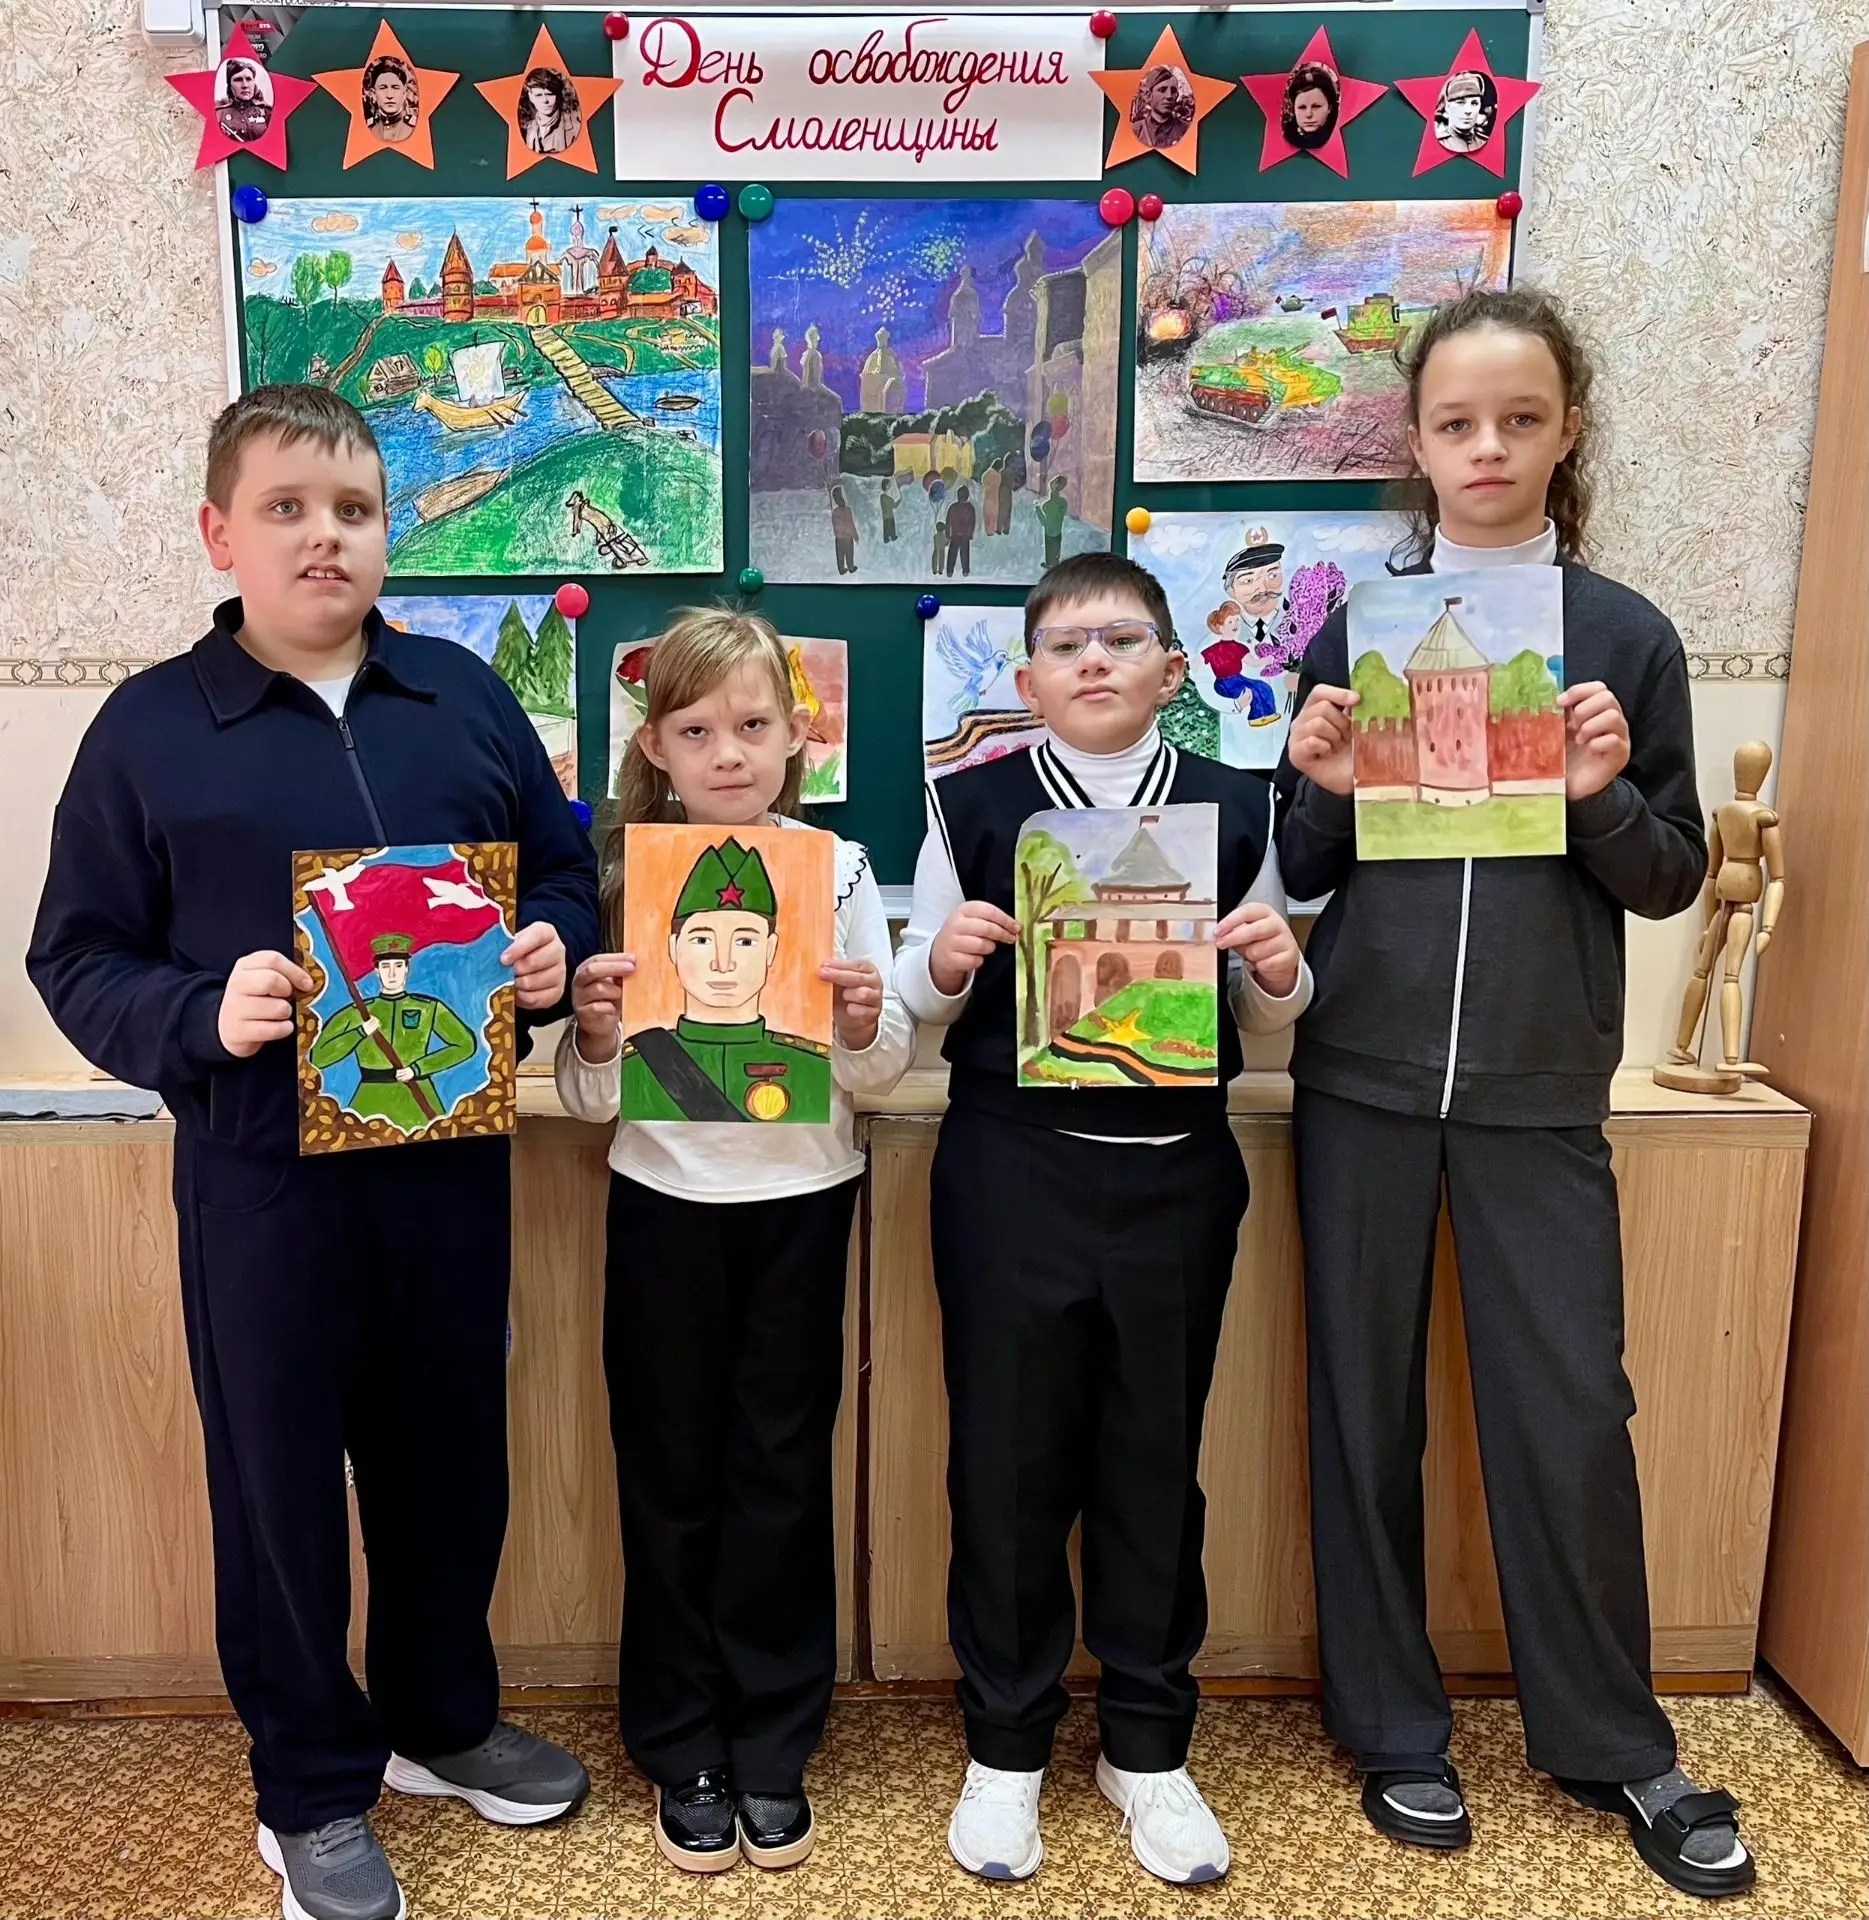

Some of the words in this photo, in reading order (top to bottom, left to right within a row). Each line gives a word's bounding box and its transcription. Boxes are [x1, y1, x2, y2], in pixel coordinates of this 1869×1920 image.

[640, 17, 764, 89] День
[808, 18, 1069, 115] освобождения
[714, 87, 999, 163] Смоленщины
